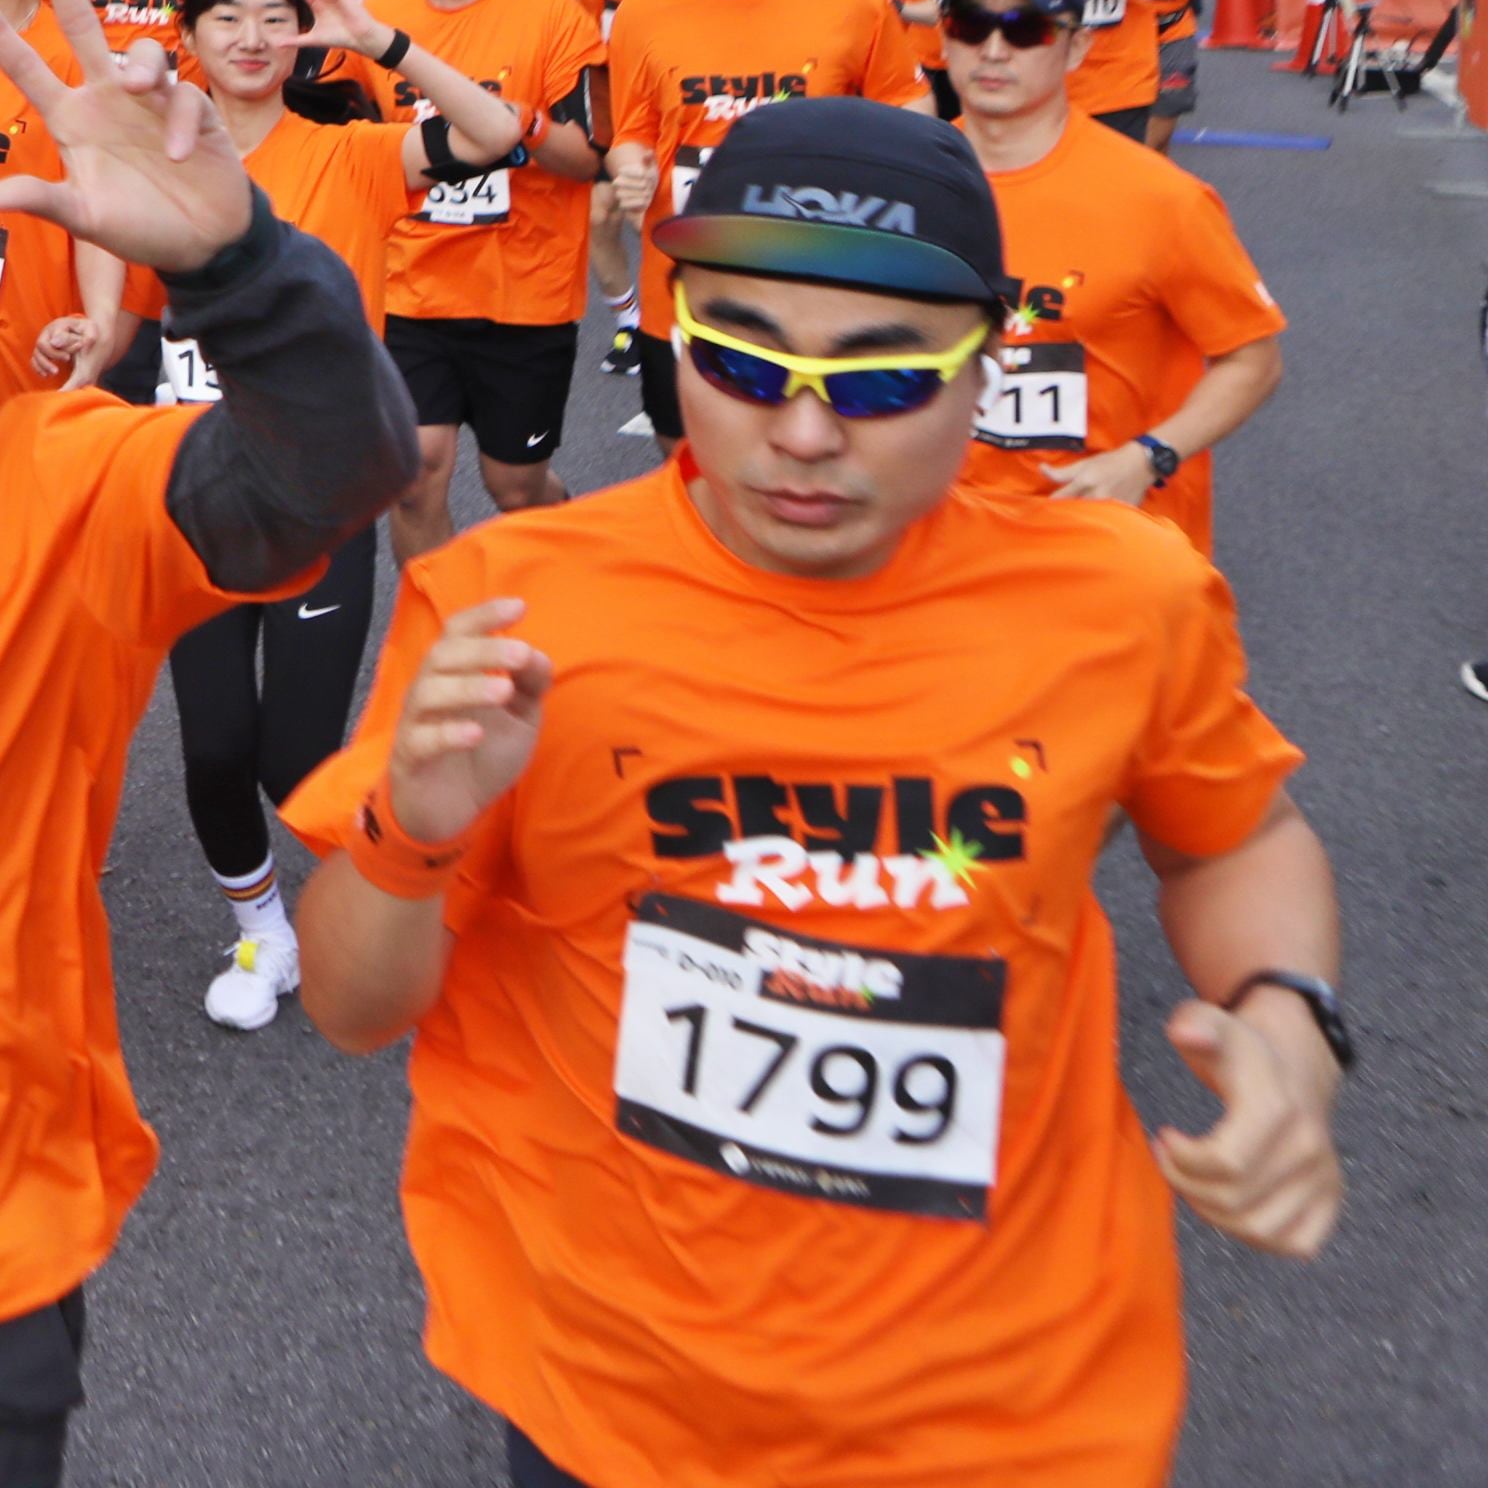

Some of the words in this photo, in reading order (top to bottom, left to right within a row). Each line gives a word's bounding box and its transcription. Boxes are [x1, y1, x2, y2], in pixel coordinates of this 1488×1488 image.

[680, 72, 807, 105] Style
[645, 774, 1029, 863] Style
[713, 833, 970, 912] Run
[663, 1005, 958, 1147] 1799
